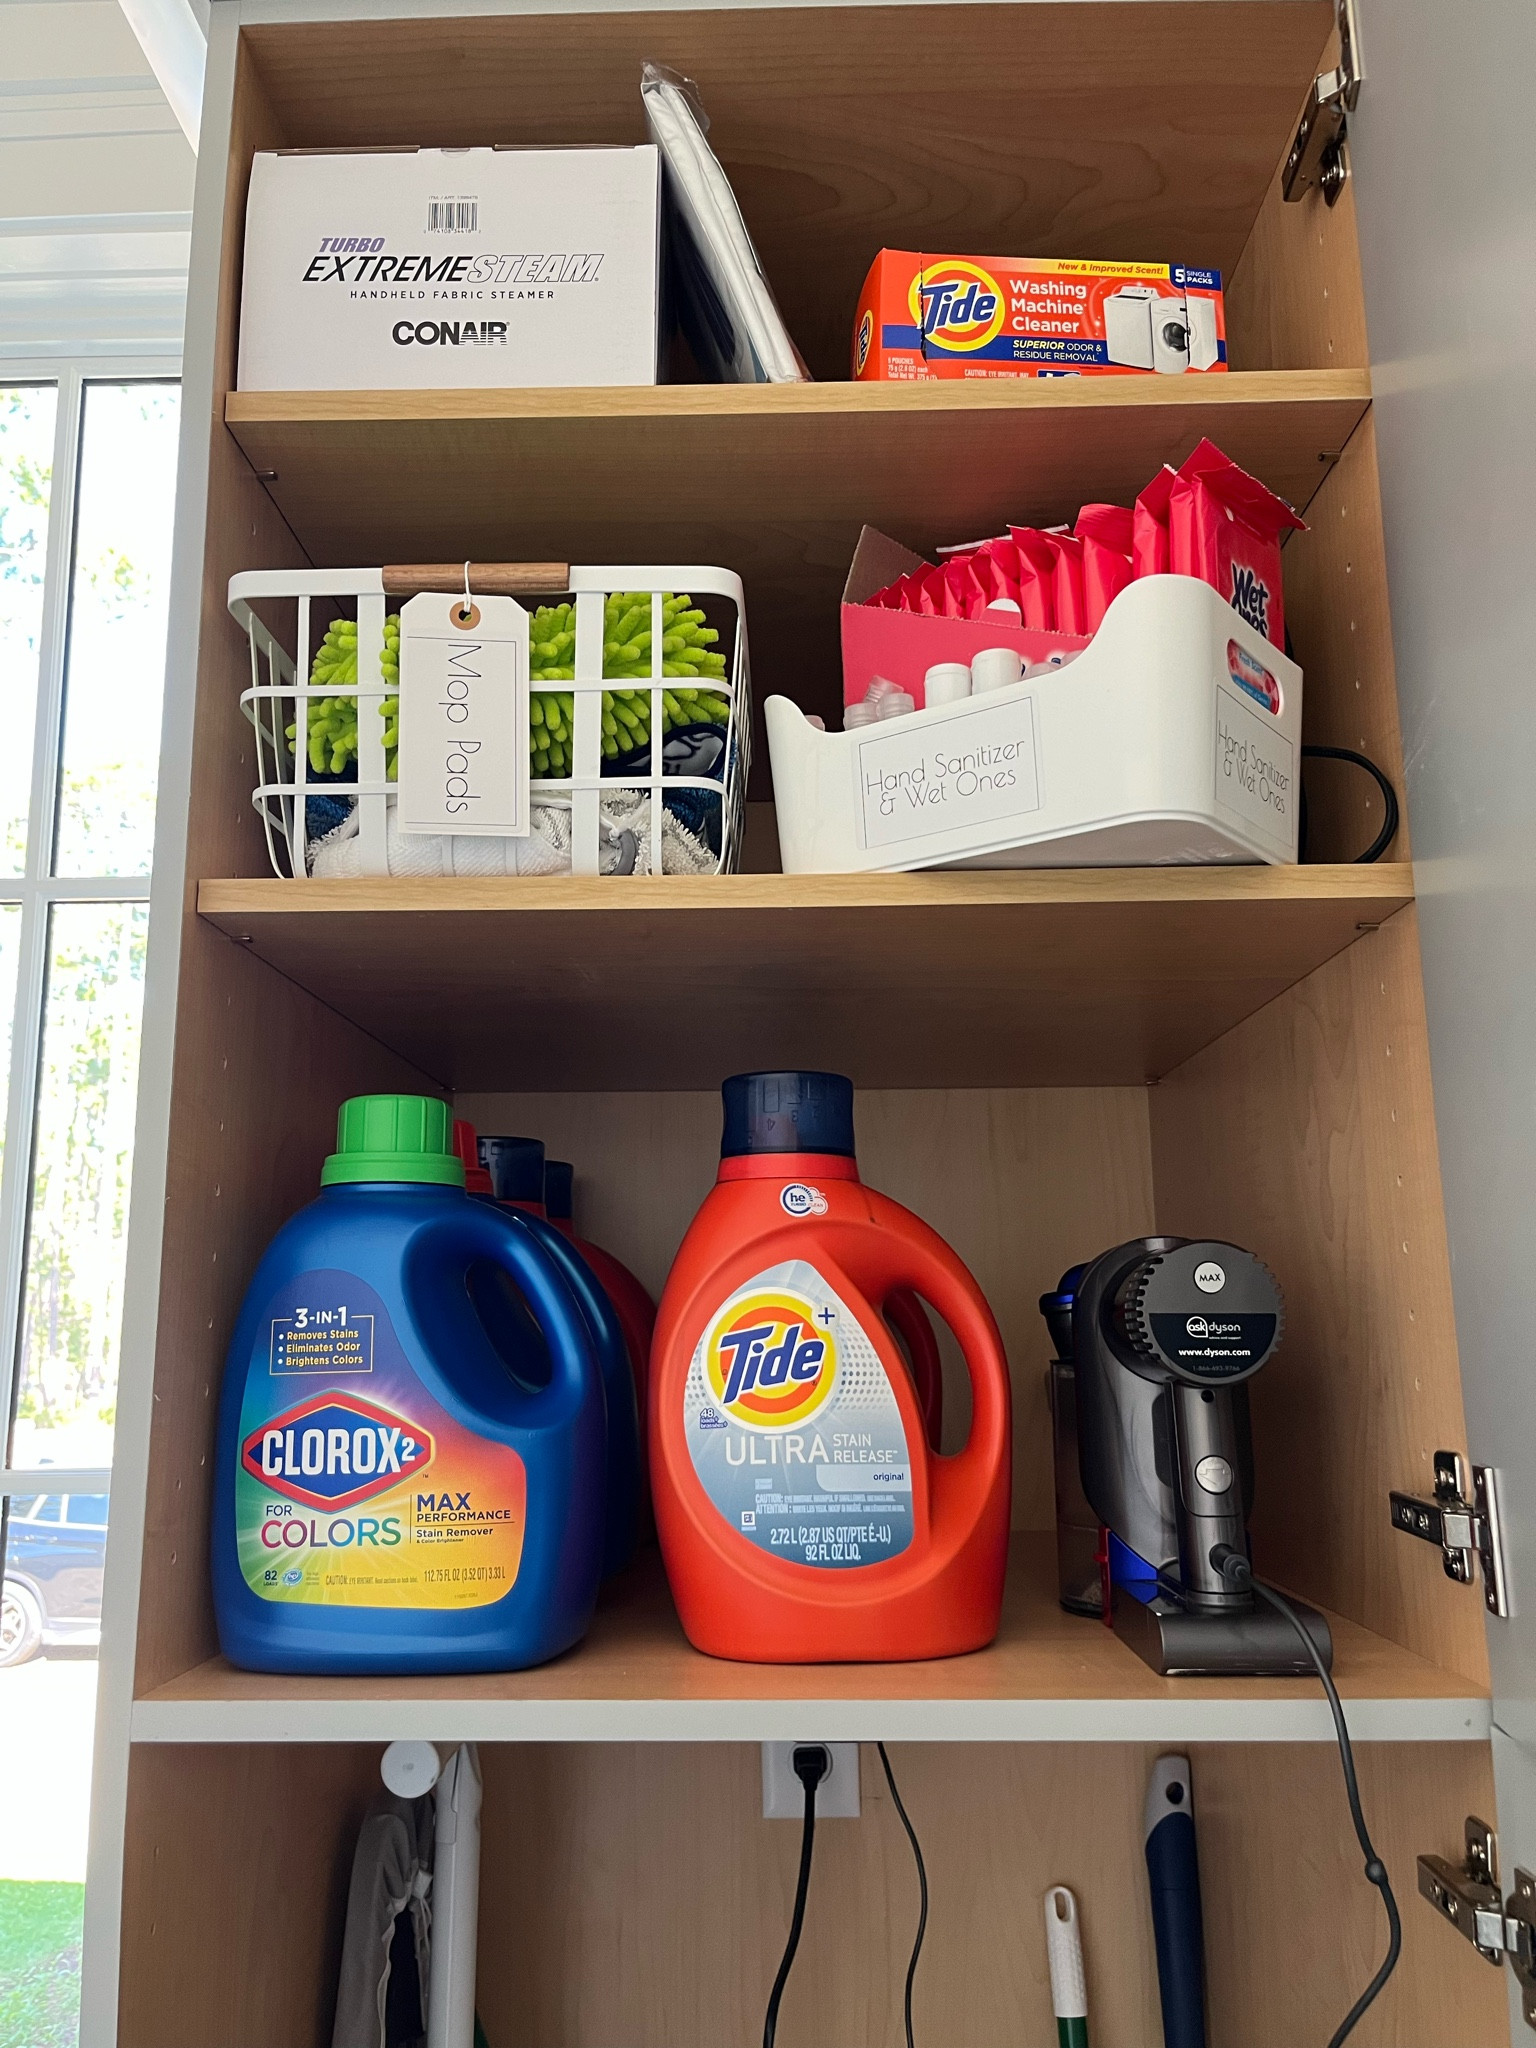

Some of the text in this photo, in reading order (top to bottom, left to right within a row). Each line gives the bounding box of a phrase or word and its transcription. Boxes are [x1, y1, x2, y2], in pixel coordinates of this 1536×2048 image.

[319, 237, 386, 253] TURBO
[1057, 262, 1164, 275] New & Improved Scent!
[1174, 268, 1186, 283] 5
[1186, 270, 1212, 279] SINGLE
[1187, 276, 1213, 285] PACKS
[350, 290, 554, 299] HANDHELD FABRIC STEAMER
[1009, 280, 1087, 299] Washing
[919, 282, 998, 335] Tide
[1011, 298, 1085, 315] Machine
[1012, 316, 1080, 333] Cleaner
[392, 321, 508, 346] CONAIR
[1012, 339, 1102, 352] SUPERIOR ODOR &
[1013, 350, 1098, 362] RESIDUE REMOVAL
[1232, 562, 1268, 618] Wet
[438, 643, 482, 814] Mop Pads
[1218, 720, 1289, 791] Hand Sanitizer
[866, 740, 1025, 796] Hand Sanitizer
[879, 769, 1017, 816] & Wet Ones
[1236, 757, 1256, 796] Wet
[1259, 776, 1285, 814] Ones
[790, 1192, 806, 1203] he
[1199, 1273, 1222, 1282] MAX
[294, 1305, 347, 1329] 3-IN-1
[286, 1328, 359, 1341] Removes Stains
[1188, 1321, 1241, 1335] ask dyson
[286, 1341, 361, 1353] Eliminates Odor
[1178, 1347, 1251, 1358] www.dyson.com
[285, 1354, 364, 1367] Brightens Colors
[719, 1323, 826, 1405] Tide
[701, 1408, 714, 1418] 48
[832, 1433, 872, 1447] STAIN
[725, 1434, 830, 1466] ULTRA
[833, 1449, 893, 1464] RELEASE
[873, 1472, 905, 1482] original
[417, 1492, 471, 1512] MAX
[266, 1504, 293, 1516] FOR
[416, 1509, 511, 1522] PERFORMANCE
[261, 1517, 401, 1549] COLORS
[416, 1527, 494, 1538] Stain Remover
[770, 1527, 790, 1545] 2.72
[791, 1527, 798, 1544] L
[798, 1525, 821, 1546] (2.87
[822, 1526, 835, 1544] US
[836, 1525, 868, 1544] QT/PTE
[805, 1543, 862, 1561] 92 FL OZ LIQ.
[264, 1570, 278, 1581] 82
[424, 1569, 444, 1582] 112.75
[443, 1568, 451, 1582] FL
[452, 1568, 460, 1581] OZ
[461, 1567, 476, 1584] (3.52
[489, 1566, 501, 1580] 3.33
